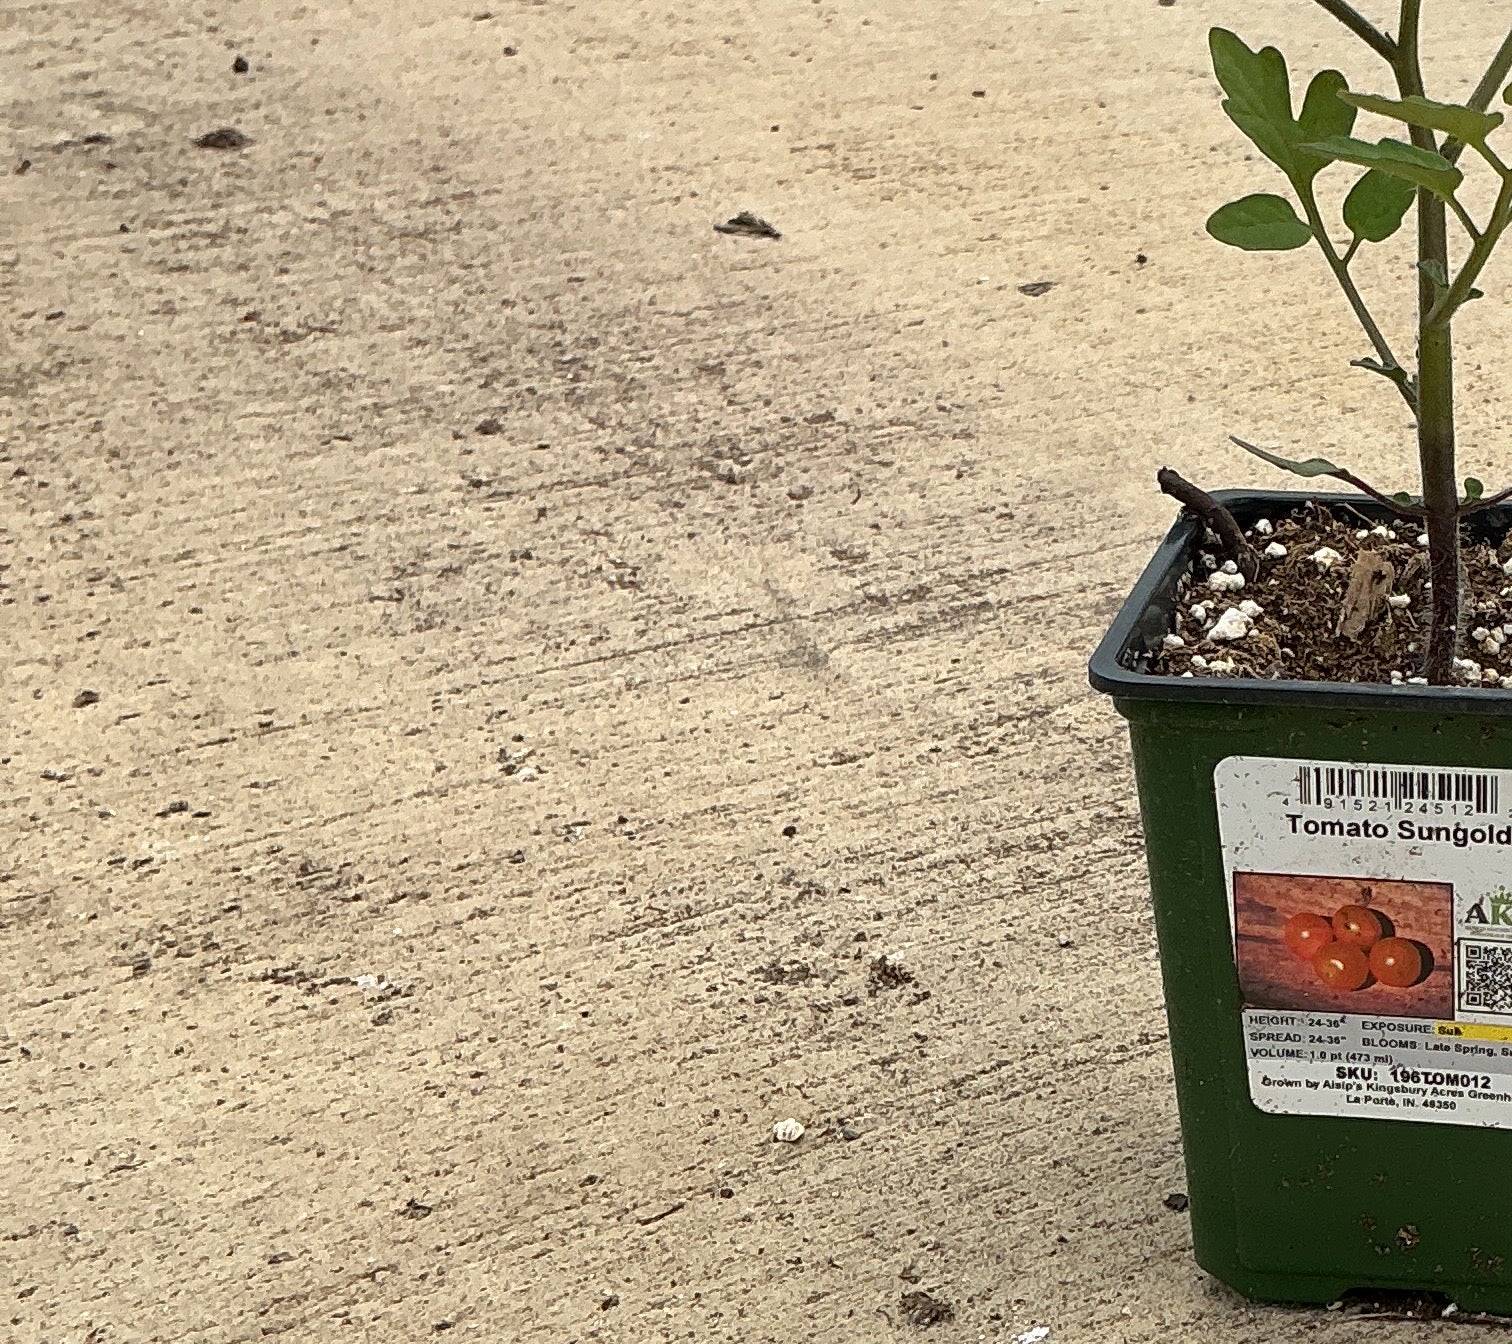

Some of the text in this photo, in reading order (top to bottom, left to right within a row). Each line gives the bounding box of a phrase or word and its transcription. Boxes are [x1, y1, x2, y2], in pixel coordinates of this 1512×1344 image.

[1323, 797, 1392, 813] 91521
[1404, 801, 1474, 817] 24512
[1285, 813, 1512, 848] Tomato Sungold
[1361, 1020, 1436, 1035] EXPOSURE:
[1248, 1031, 1306, 1043] SPREAD:
[1361, 1037, 1422, 1050] BLOOMS:
[1425, 1041, 1451, 1052] Late
[1250, 1047, 1307, 1059] VOLUME:
[1330, 1051, 1343, 1062] pt
[1346, 1051, 1371, 1064] (473
[1374, 1054, 1393, 1066] ml)
[1261, 1075, 1302, 1088] Grown
[1305, 1078, 1321, 1090] by
[1323, 1079, 1363, 1092] Alsip's
[1366, 1082, 1428, 1097] Kingsbury
[1430, 1086, 1464, 1098] Acres
[1336, 1065, 1491, 1090] SKU: 196TOM012
[1346, 1094, 1360, 1104] La
